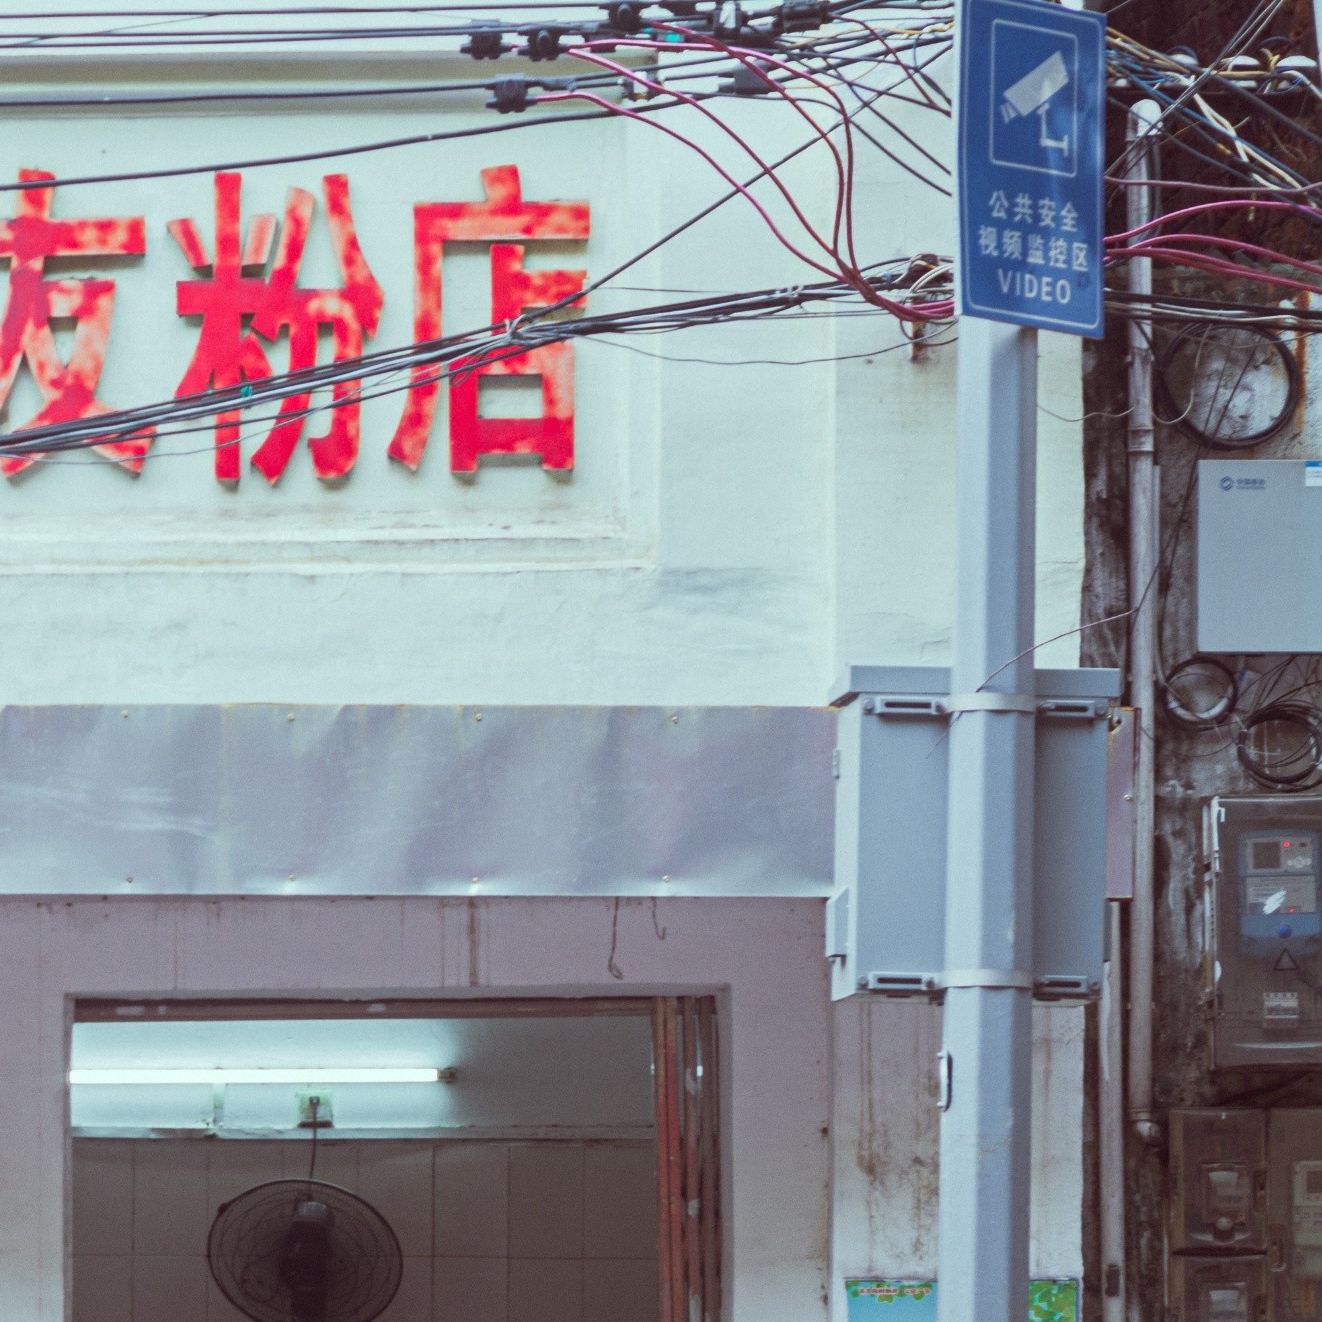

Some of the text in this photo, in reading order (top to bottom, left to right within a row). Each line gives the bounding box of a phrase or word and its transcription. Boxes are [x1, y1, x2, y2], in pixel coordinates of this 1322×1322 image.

[988, 189, 1079, 233] 公共安全
[977, 222, 1090, 273] 视频监控区
[997, 268, 1071, 305] VIDEO
